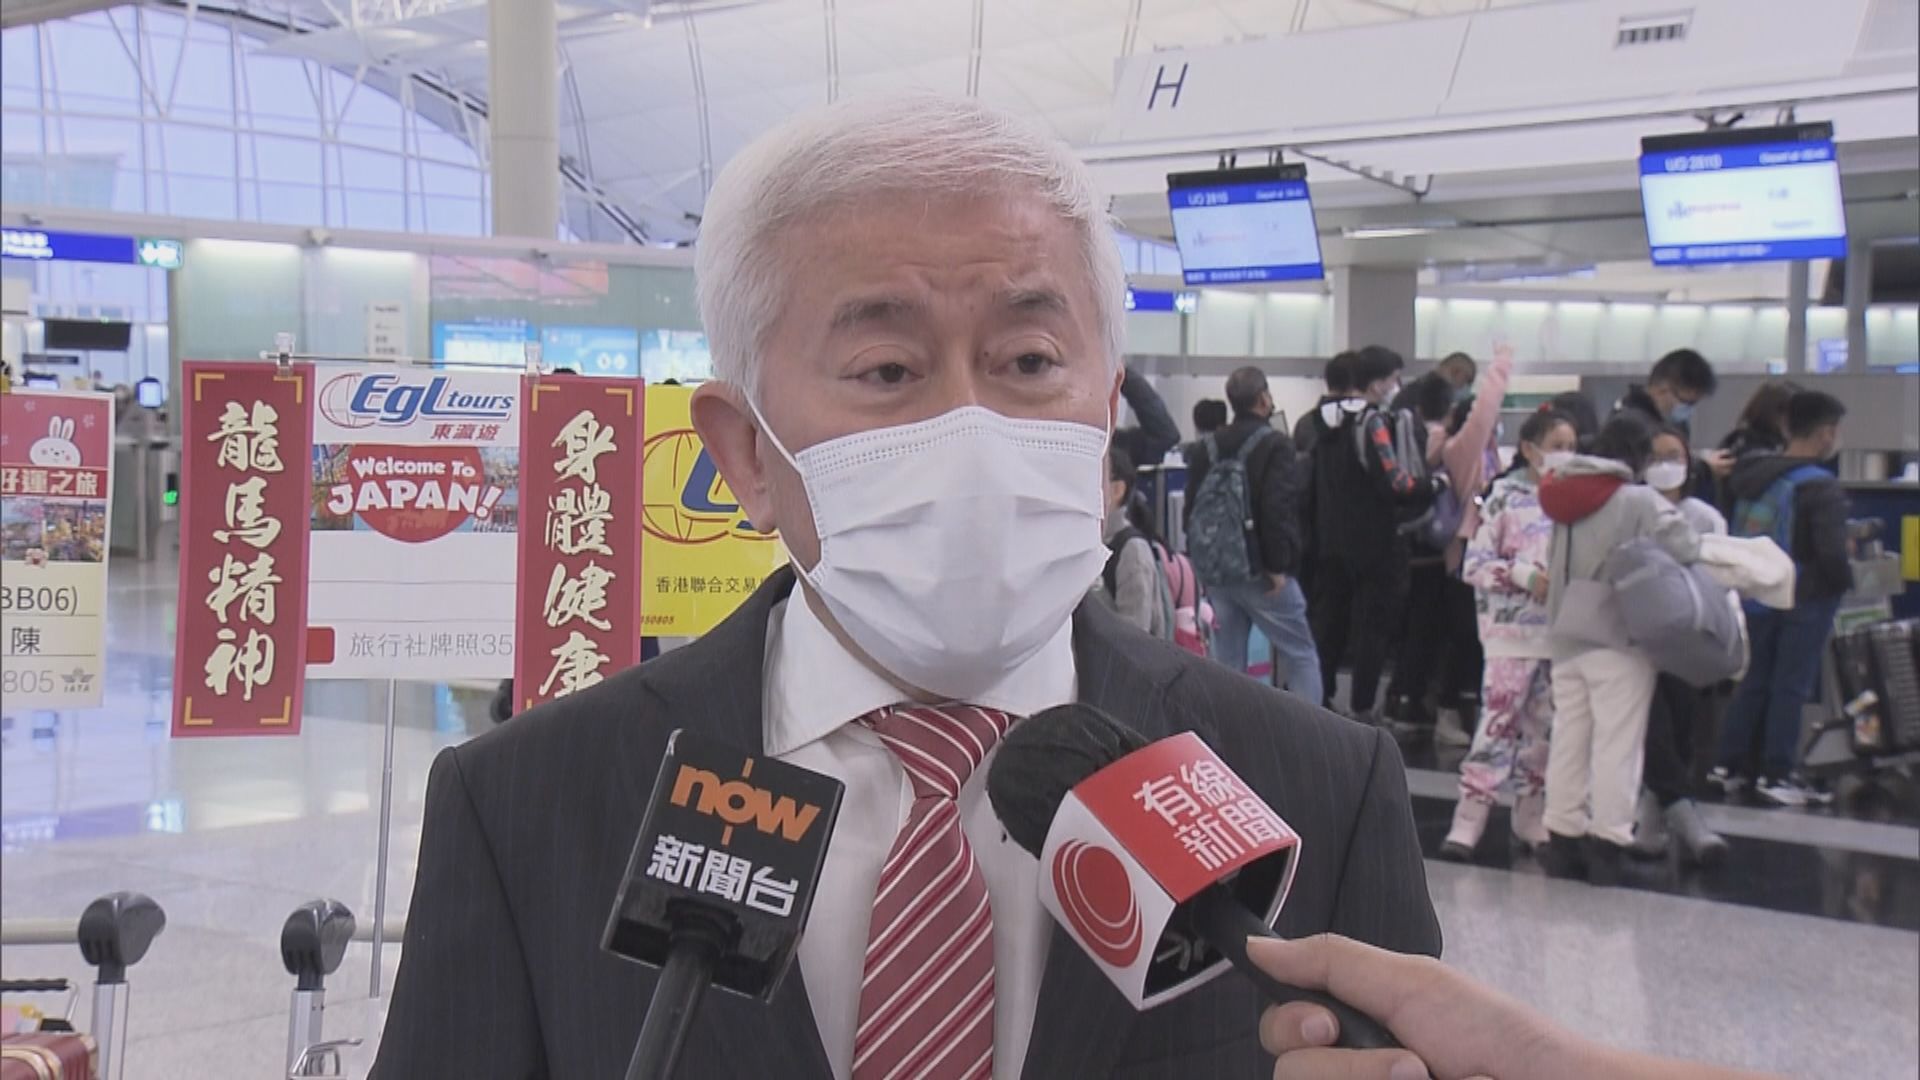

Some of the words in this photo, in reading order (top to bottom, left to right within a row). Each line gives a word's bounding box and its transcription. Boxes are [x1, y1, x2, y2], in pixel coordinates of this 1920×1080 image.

[1147, 63, 1188, 110] H
[448, 390, 514, 410] tours
[430, 424, 501, 441] 東瀛遊
[352, 456, 446, 479] Welcome
[451, 460, 477, 477] To
[327, 479, 504, 519] JAPAN!
[204, 400, 285, 702] 龍馬精神
[538, 409, 617, 699] 身體健康
[656, 576, 766, 594] 香港聯合交易
[11, 626, 41, 655] 陳
[670, 764, 821, 842] now
[1132, 759, 1250, 827] 有線
[1173, 798, 1289, 872] 新聞
[647, 834, 799, 918] 新聞台
